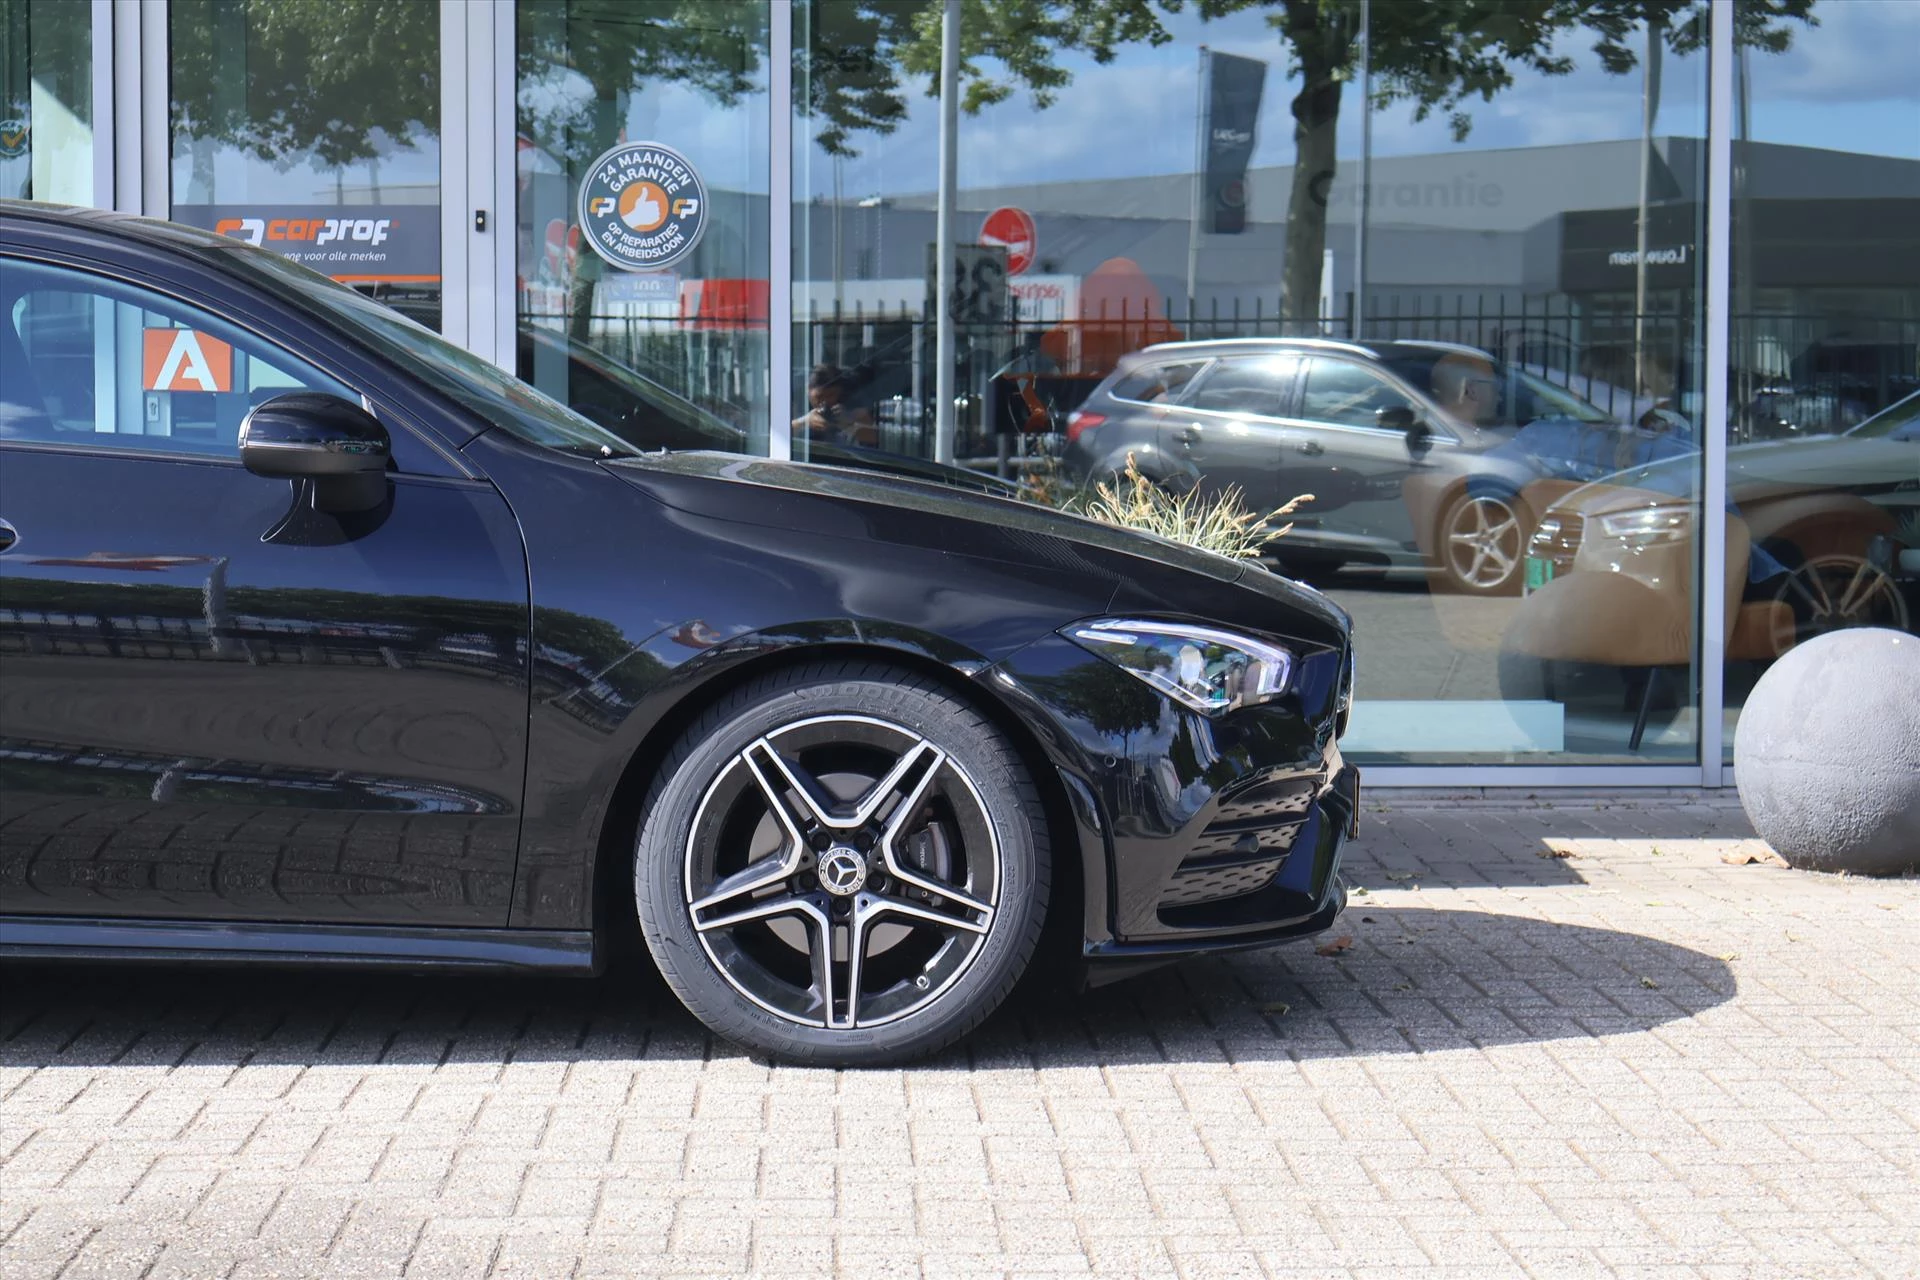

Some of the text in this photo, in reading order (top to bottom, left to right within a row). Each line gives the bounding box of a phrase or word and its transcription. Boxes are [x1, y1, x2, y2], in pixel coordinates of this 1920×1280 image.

[598, 152, 691, 187] 24 MAANDEN
[610, 166, 680, 195] GARANTIE
[266, 218, 390, 246] carprof
[601, 231, 685, 259] EN ARBEIDSLOON
[608, 222, 679, 249] OP REPARATIES
[304, 252, 327, 261] voor
[328, 250, 347, 261] alle
[349, 250, 387, 261] merken
